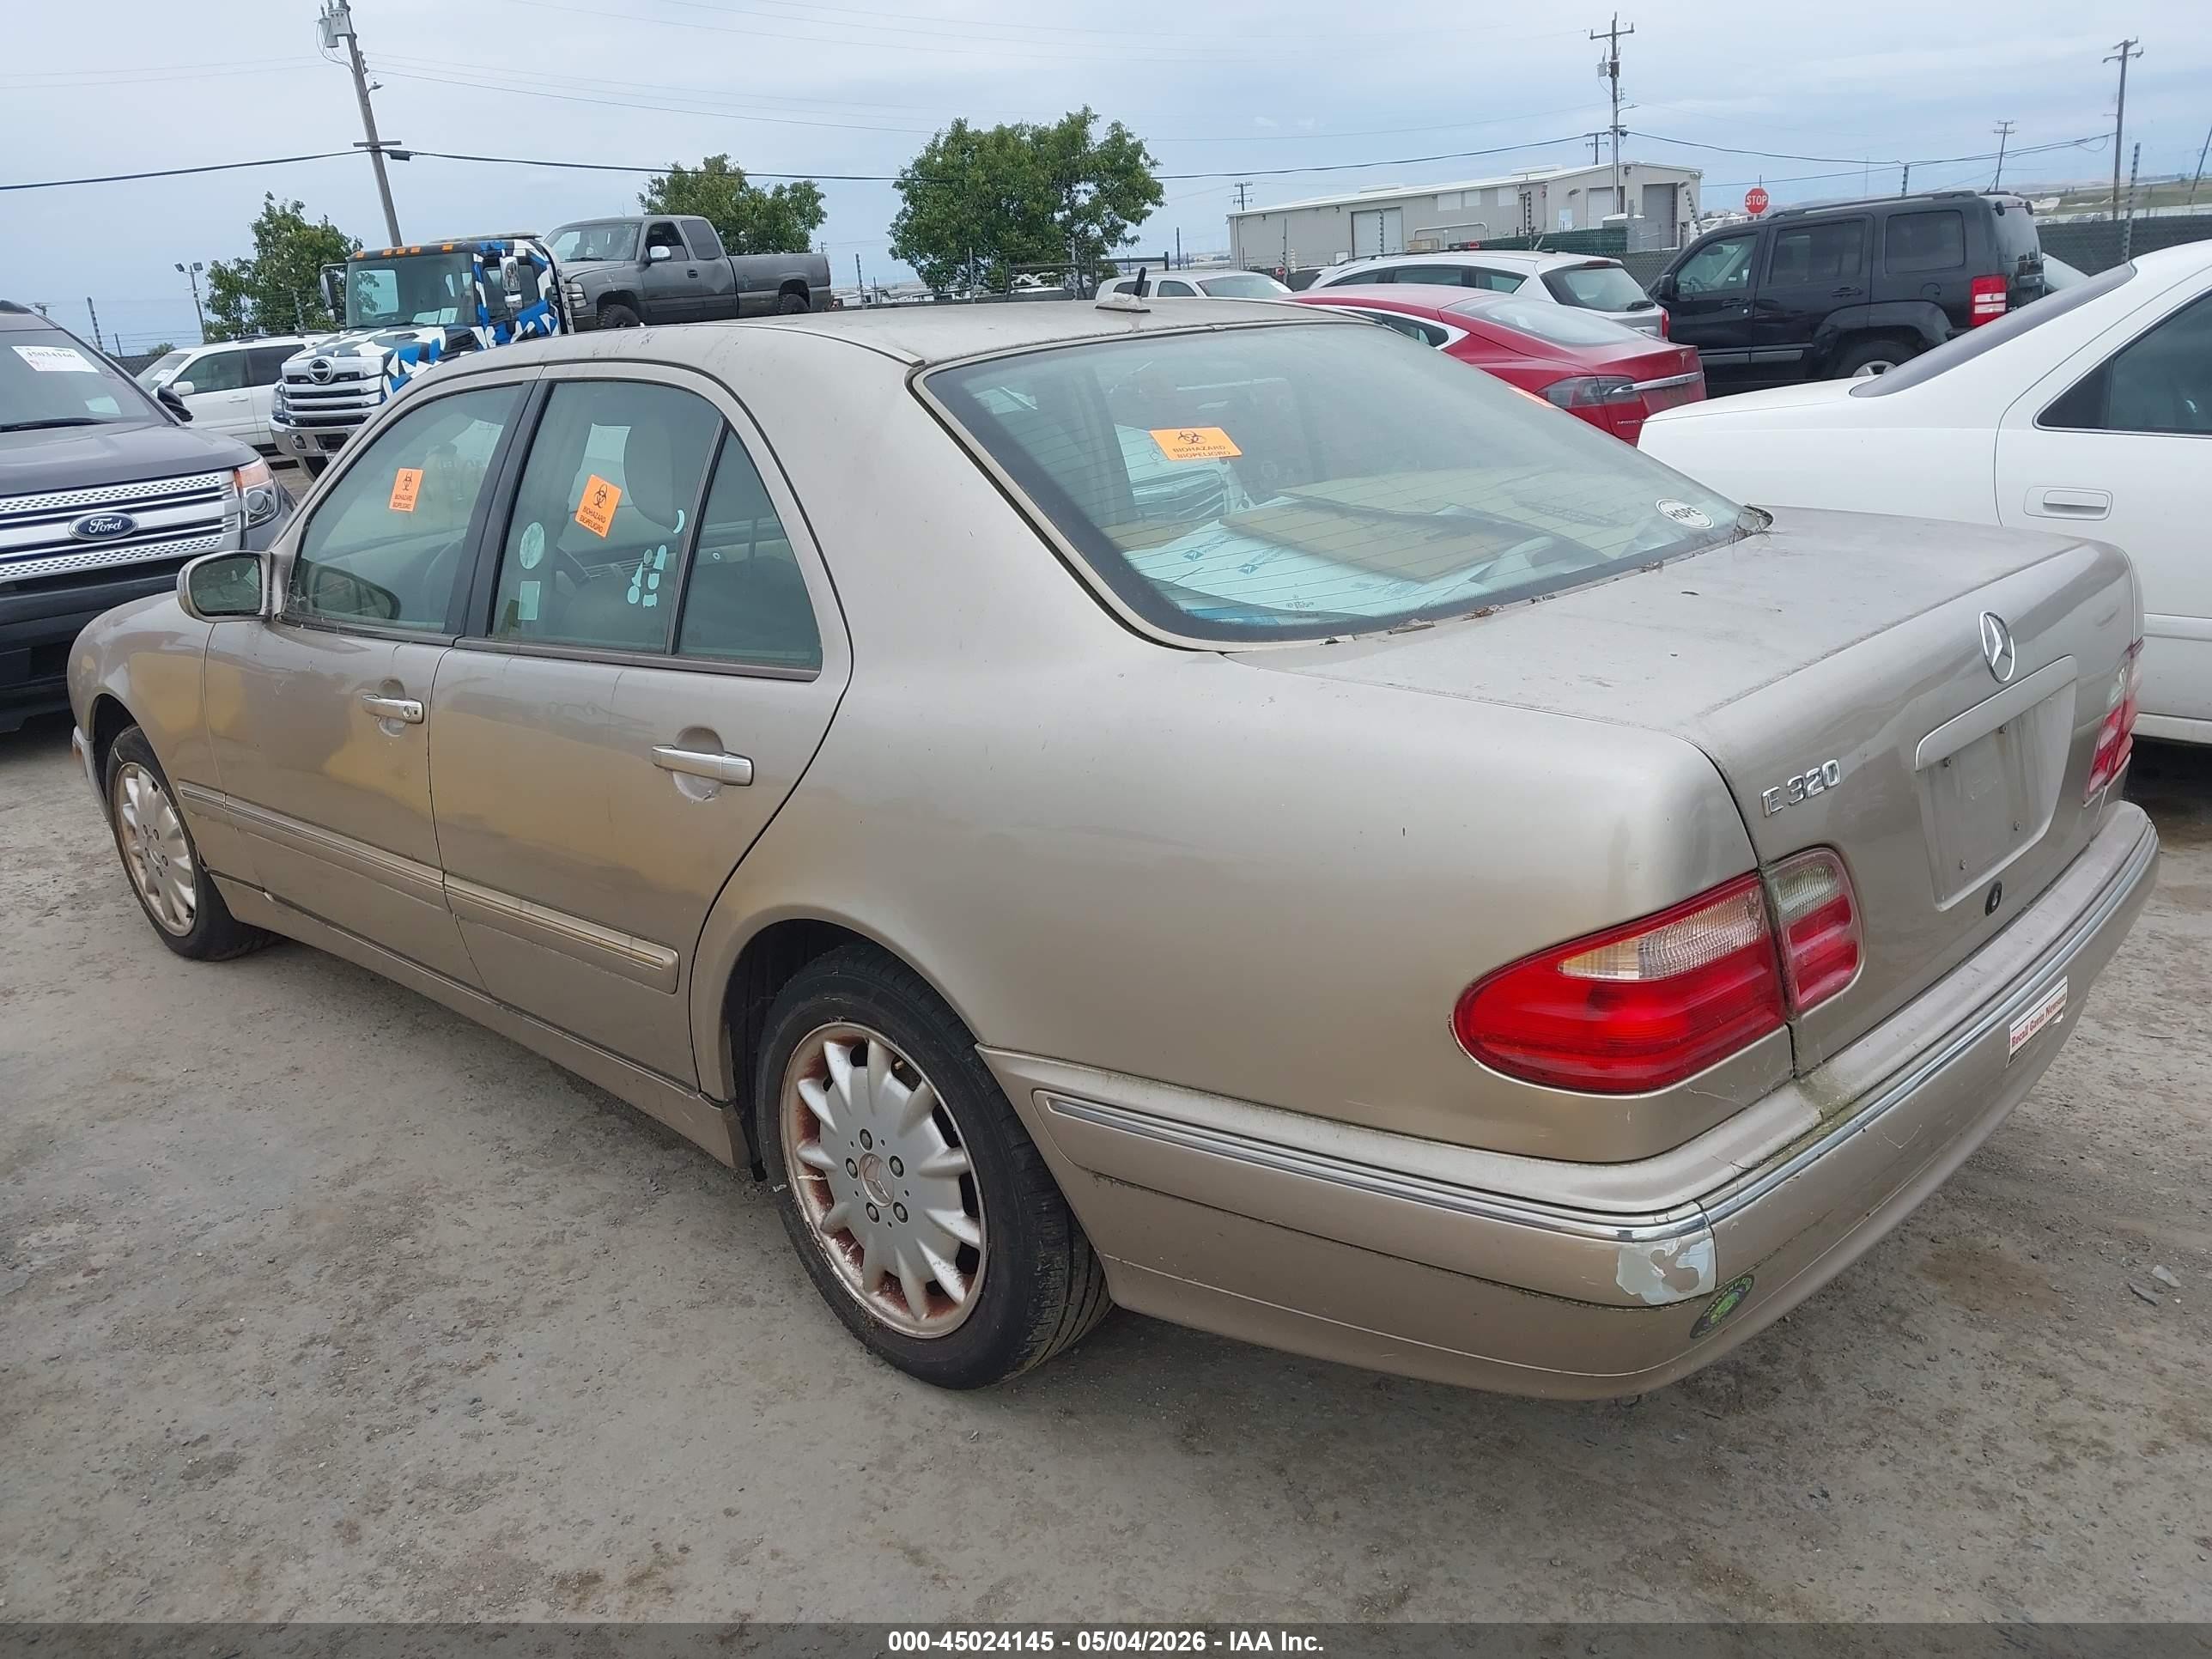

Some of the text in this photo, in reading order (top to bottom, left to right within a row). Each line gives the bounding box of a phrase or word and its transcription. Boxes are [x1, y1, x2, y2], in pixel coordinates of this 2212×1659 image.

[1746, 195, 1767, 206] STOP
[1172, 445, 1226, 453] BIOHAZARD
[1666, 507, 1702, 520] HOPE
[88, 517, 123, 534] Ford
[1760, 759, 1841, 817] E 320
[2011, 1022, 2029, 1047] Recall
[2029, 1012, 2045, 1032] Gavin
